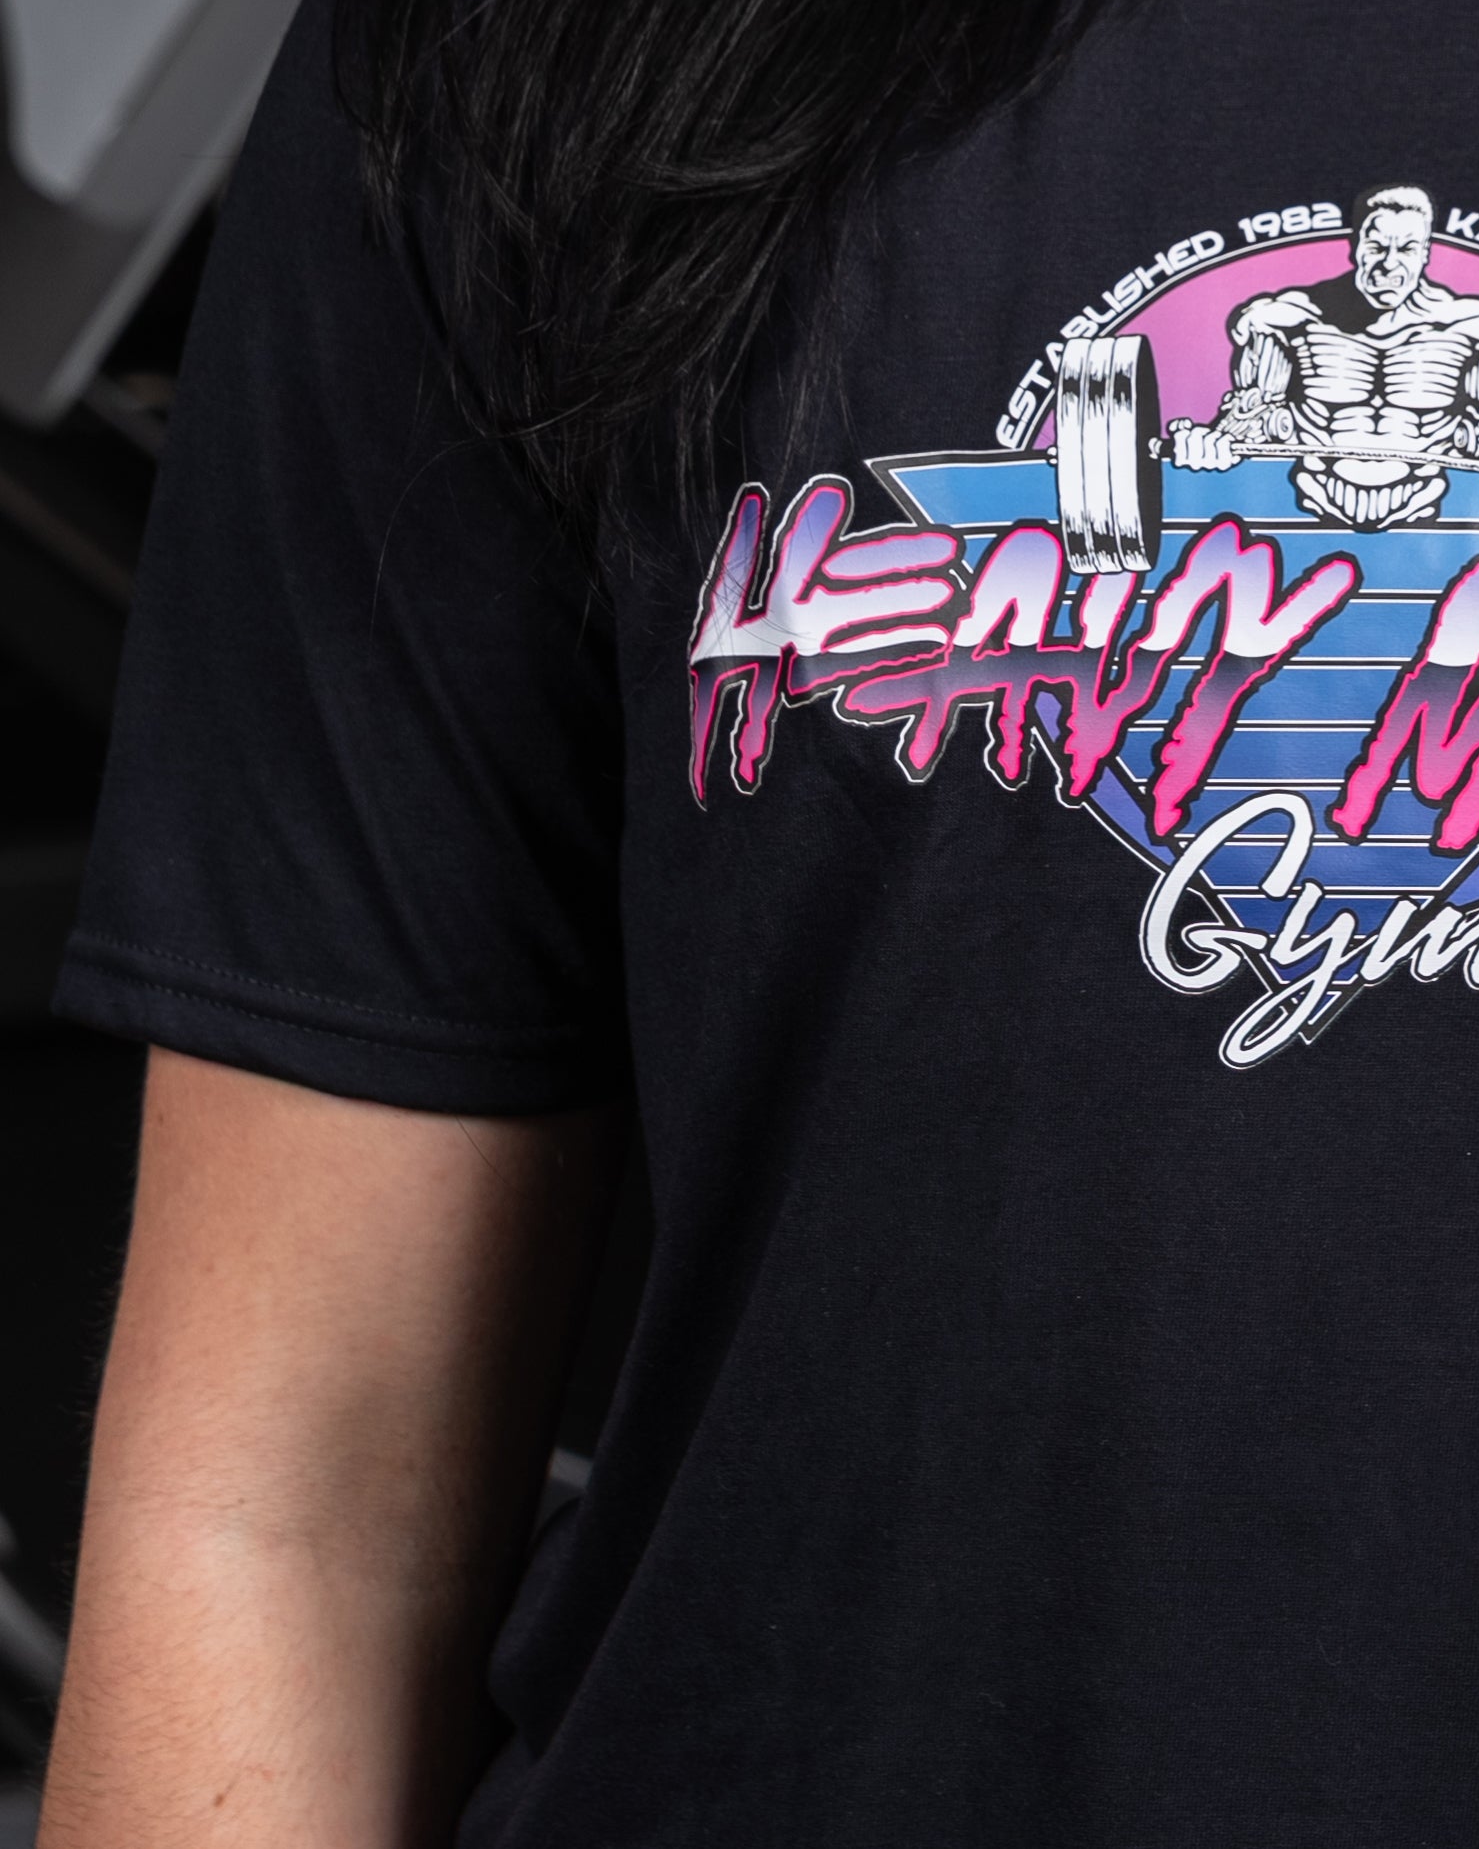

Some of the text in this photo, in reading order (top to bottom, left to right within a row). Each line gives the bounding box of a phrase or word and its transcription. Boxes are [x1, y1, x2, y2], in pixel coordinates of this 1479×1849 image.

[995, 202, 1343, 449] ESTABLISHED 1982
[689, 485, 1356, 838] HEAVY
